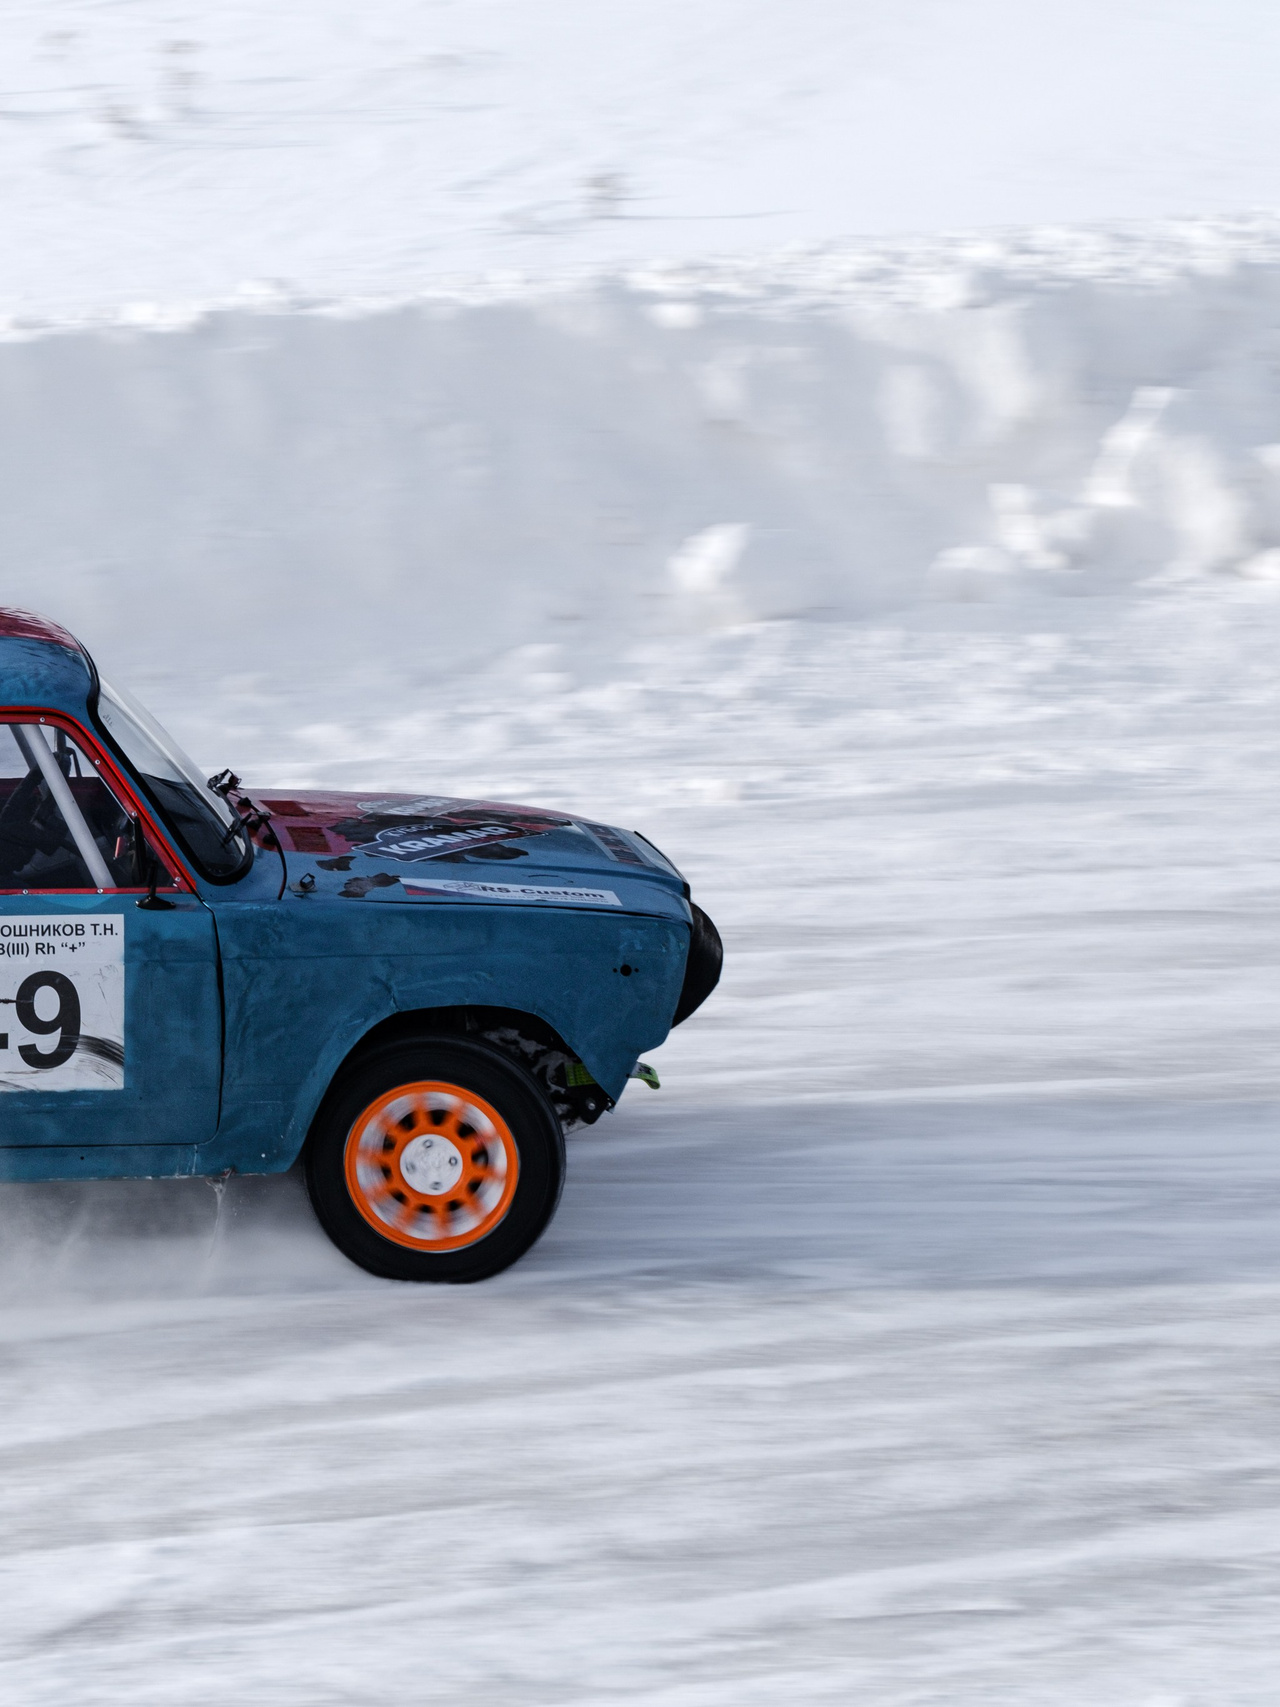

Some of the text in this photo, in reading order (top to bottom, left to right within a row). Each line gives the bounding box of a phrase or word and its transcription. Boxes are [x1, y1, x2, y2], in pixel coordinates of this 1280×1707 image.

[378, 826, 517, 855] KRAMAR
[480, 885, 605, 899] RS-Custom
[90, 923, 118, 936] Т.Н.
[35, 942, 56, 955] Rh
